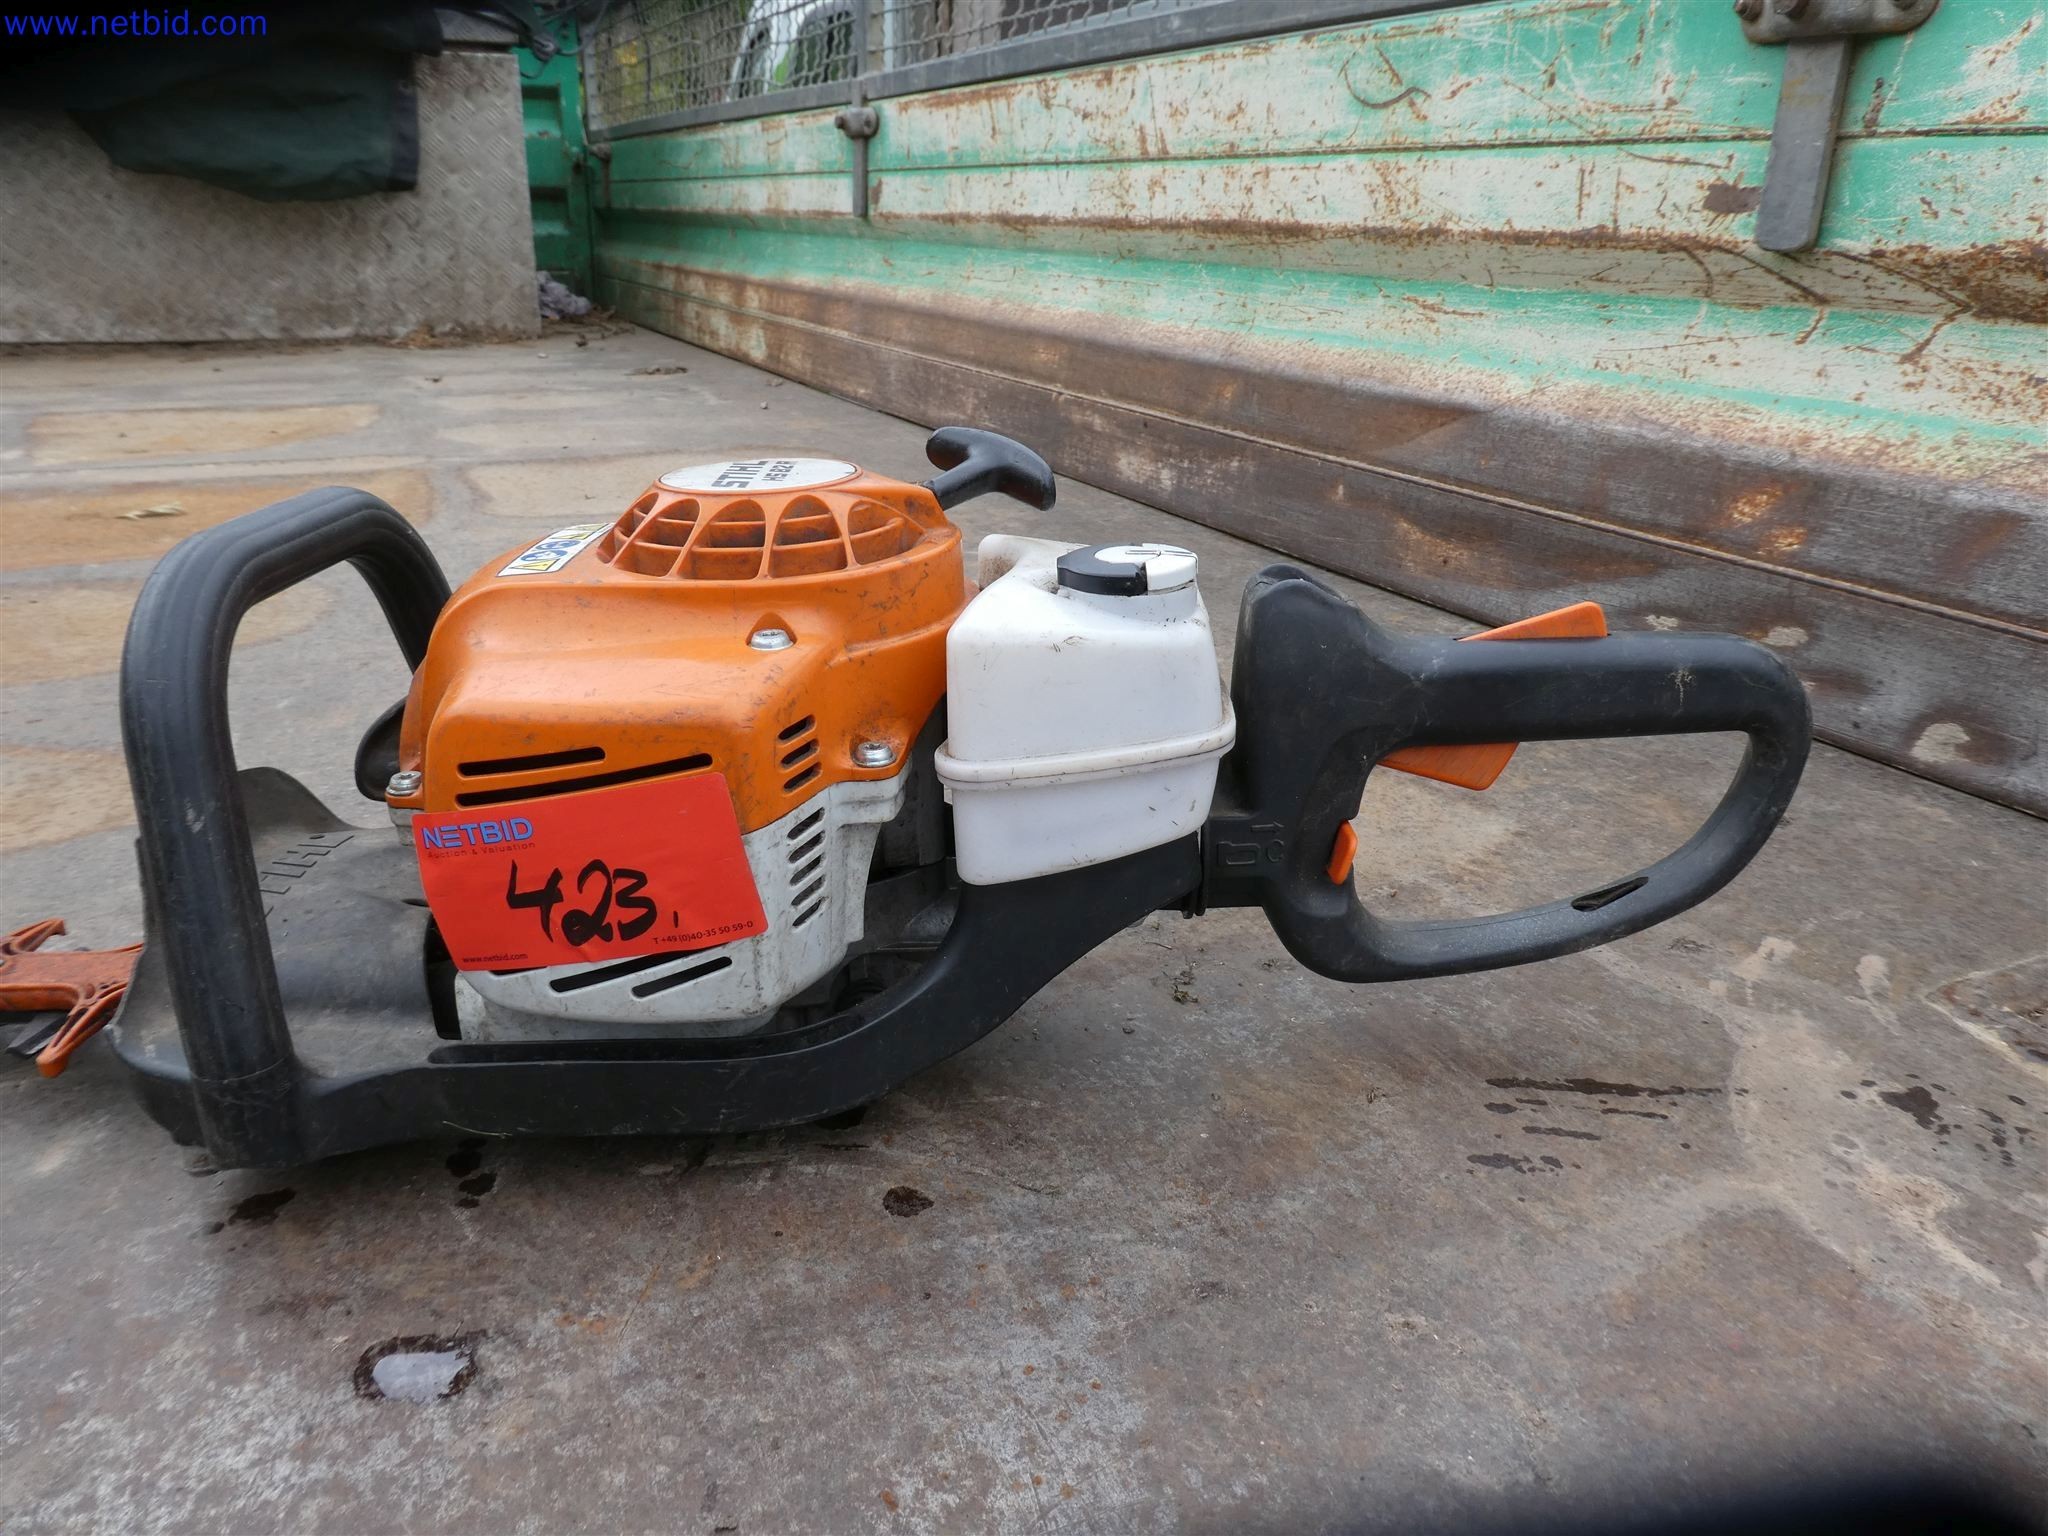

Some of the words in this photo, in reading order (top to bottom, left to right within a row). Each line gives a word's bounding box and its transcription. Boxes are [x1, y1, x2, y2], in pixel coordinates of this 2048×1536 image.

[711, 460, 769, 488] STIHL
[421, 817, 534, 849] NETBID
[428, 849, 467, 860] Auction
[471, 848, 478, 856] &
[482, 842, 536, 855] Valuation
[259, 834, 355, 919] TIHL
[653, 937, 659, 945] T
[719, 925, 730, 936] 50
[732, 920, 754, 932] 59-0
